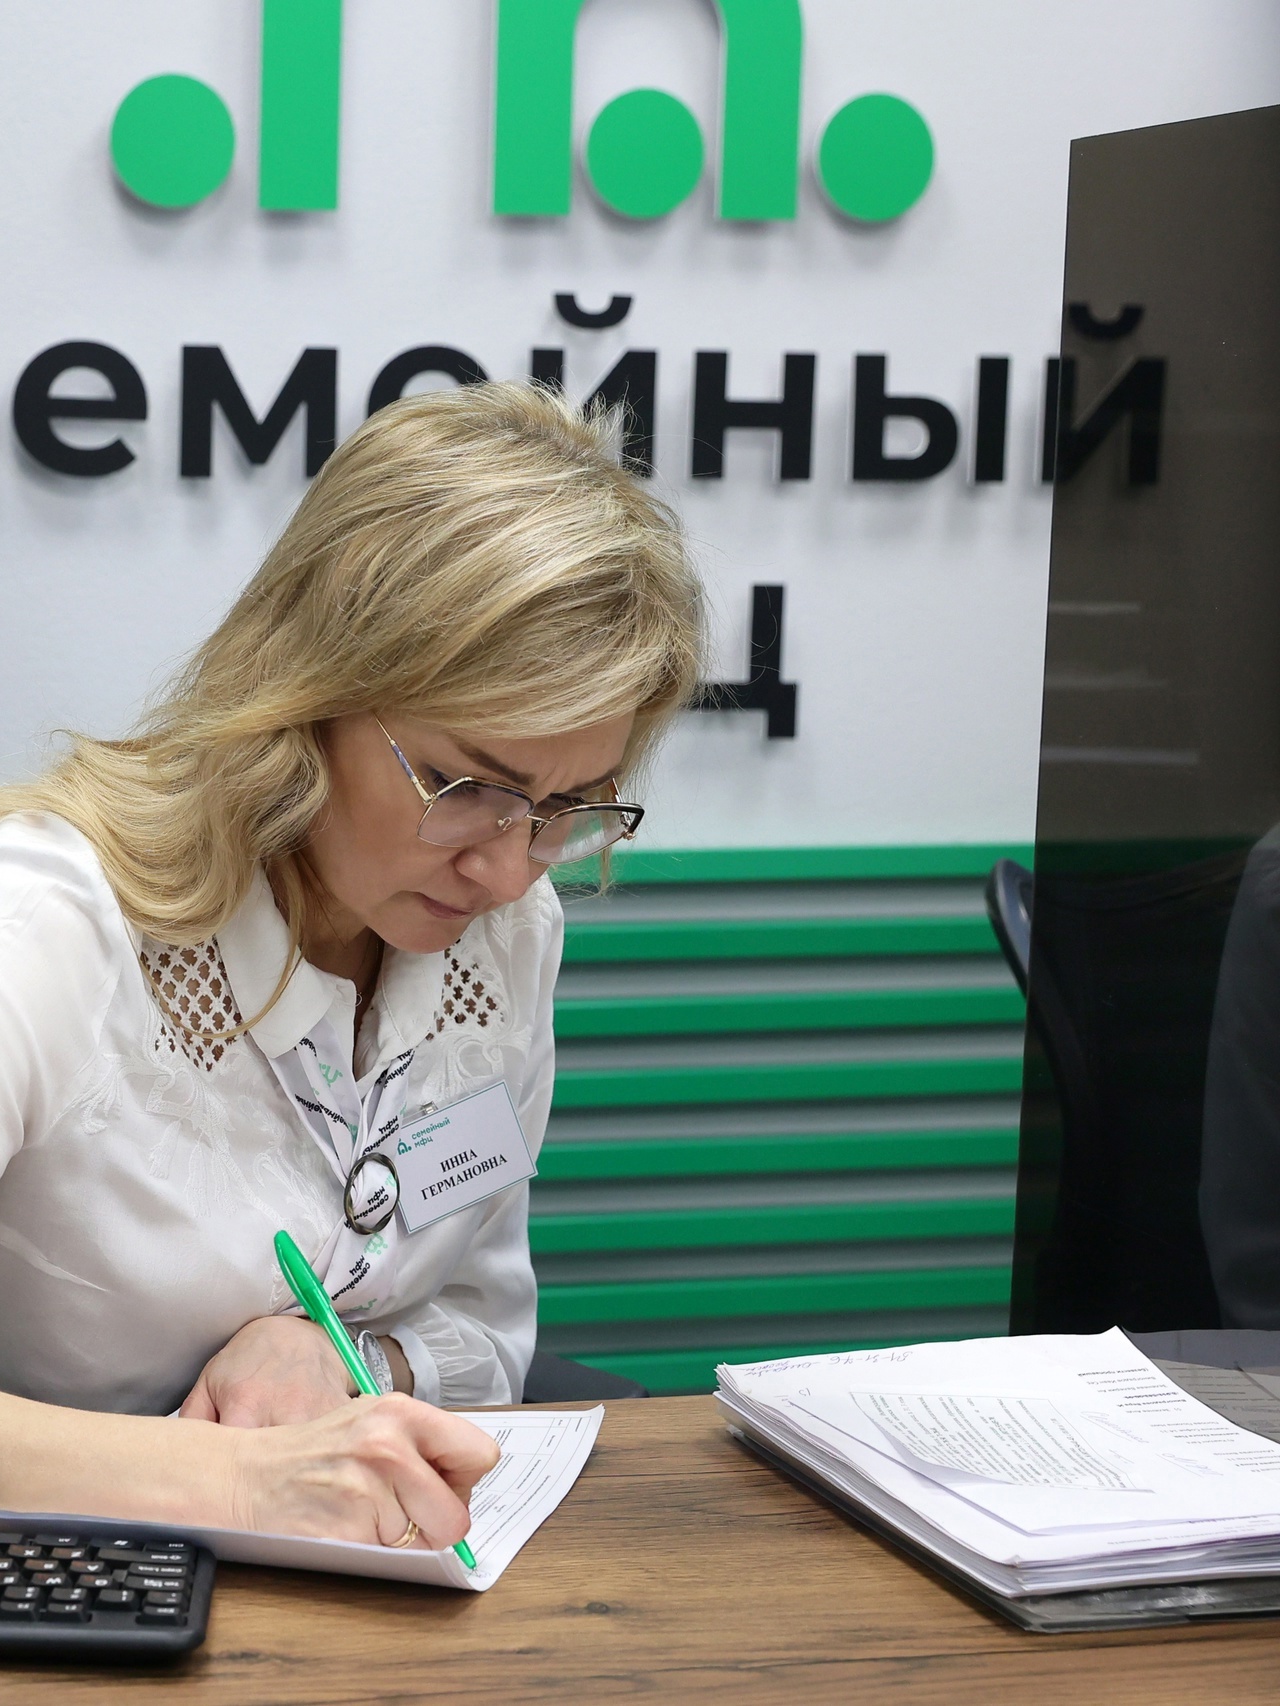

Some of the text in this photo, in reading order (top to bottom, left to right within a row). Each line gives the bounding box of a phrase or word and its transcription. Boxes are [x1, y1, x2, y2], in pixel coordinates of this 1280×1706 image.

[411, 1116, 451, 1140] семейный
[414, 1136, 434, 1148] мфц
[440, 1149, 478, 1173] ИННА
[420, 1154, 508, 1201] ГЕРМАНОВНА
